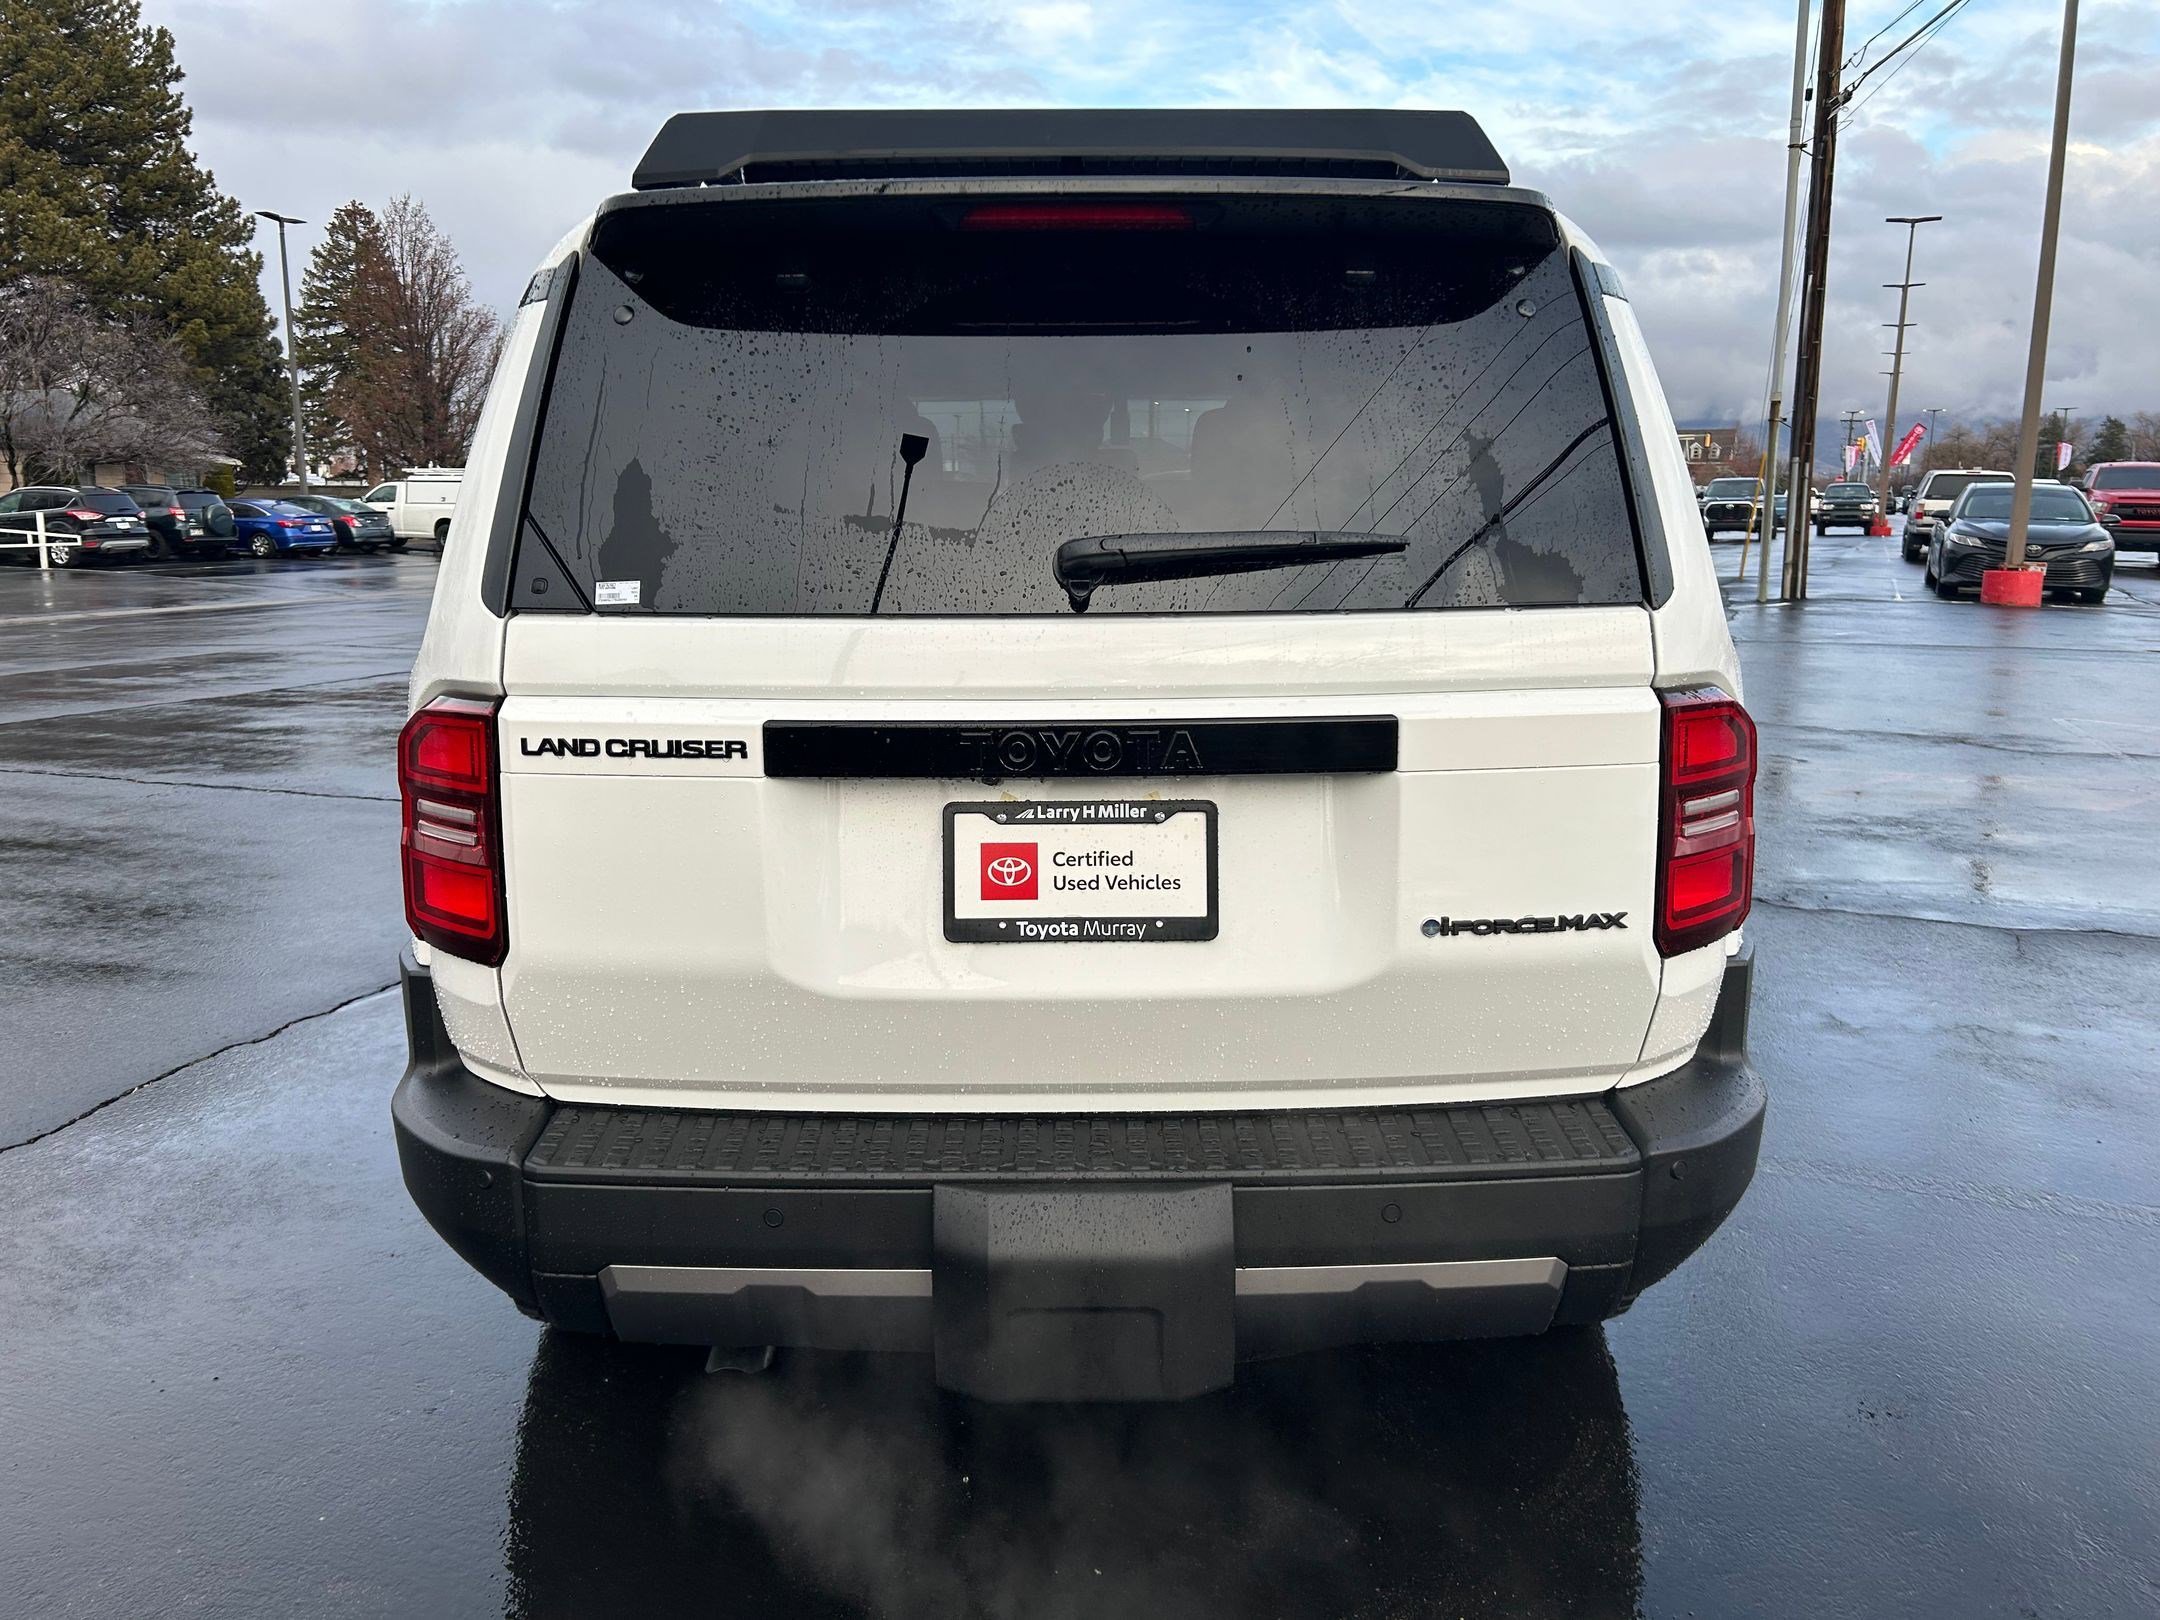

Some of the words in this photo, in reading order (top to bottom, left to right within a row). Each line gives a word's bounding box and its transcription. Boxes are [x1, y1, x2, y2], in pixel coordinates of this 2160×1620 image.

[520, 737, 601, 756] LAND
[604, 738, 748, 759] CRUISER
[959, 730, 1203, 771] TOYOTA
[1037, 805, 1080, 822] Larry
[1082, 805, 1095, 819] H
[1098, 804, 1147, 819] Miller
[1052, 850, 1134, 867] Certified
[1053, 875, 1100, 891] Used
[1105, 874, 1181, 890] Vehicles
[1016, 921, 1079, 940] Toyota
[1083, 921, 1147, 939] Murray
